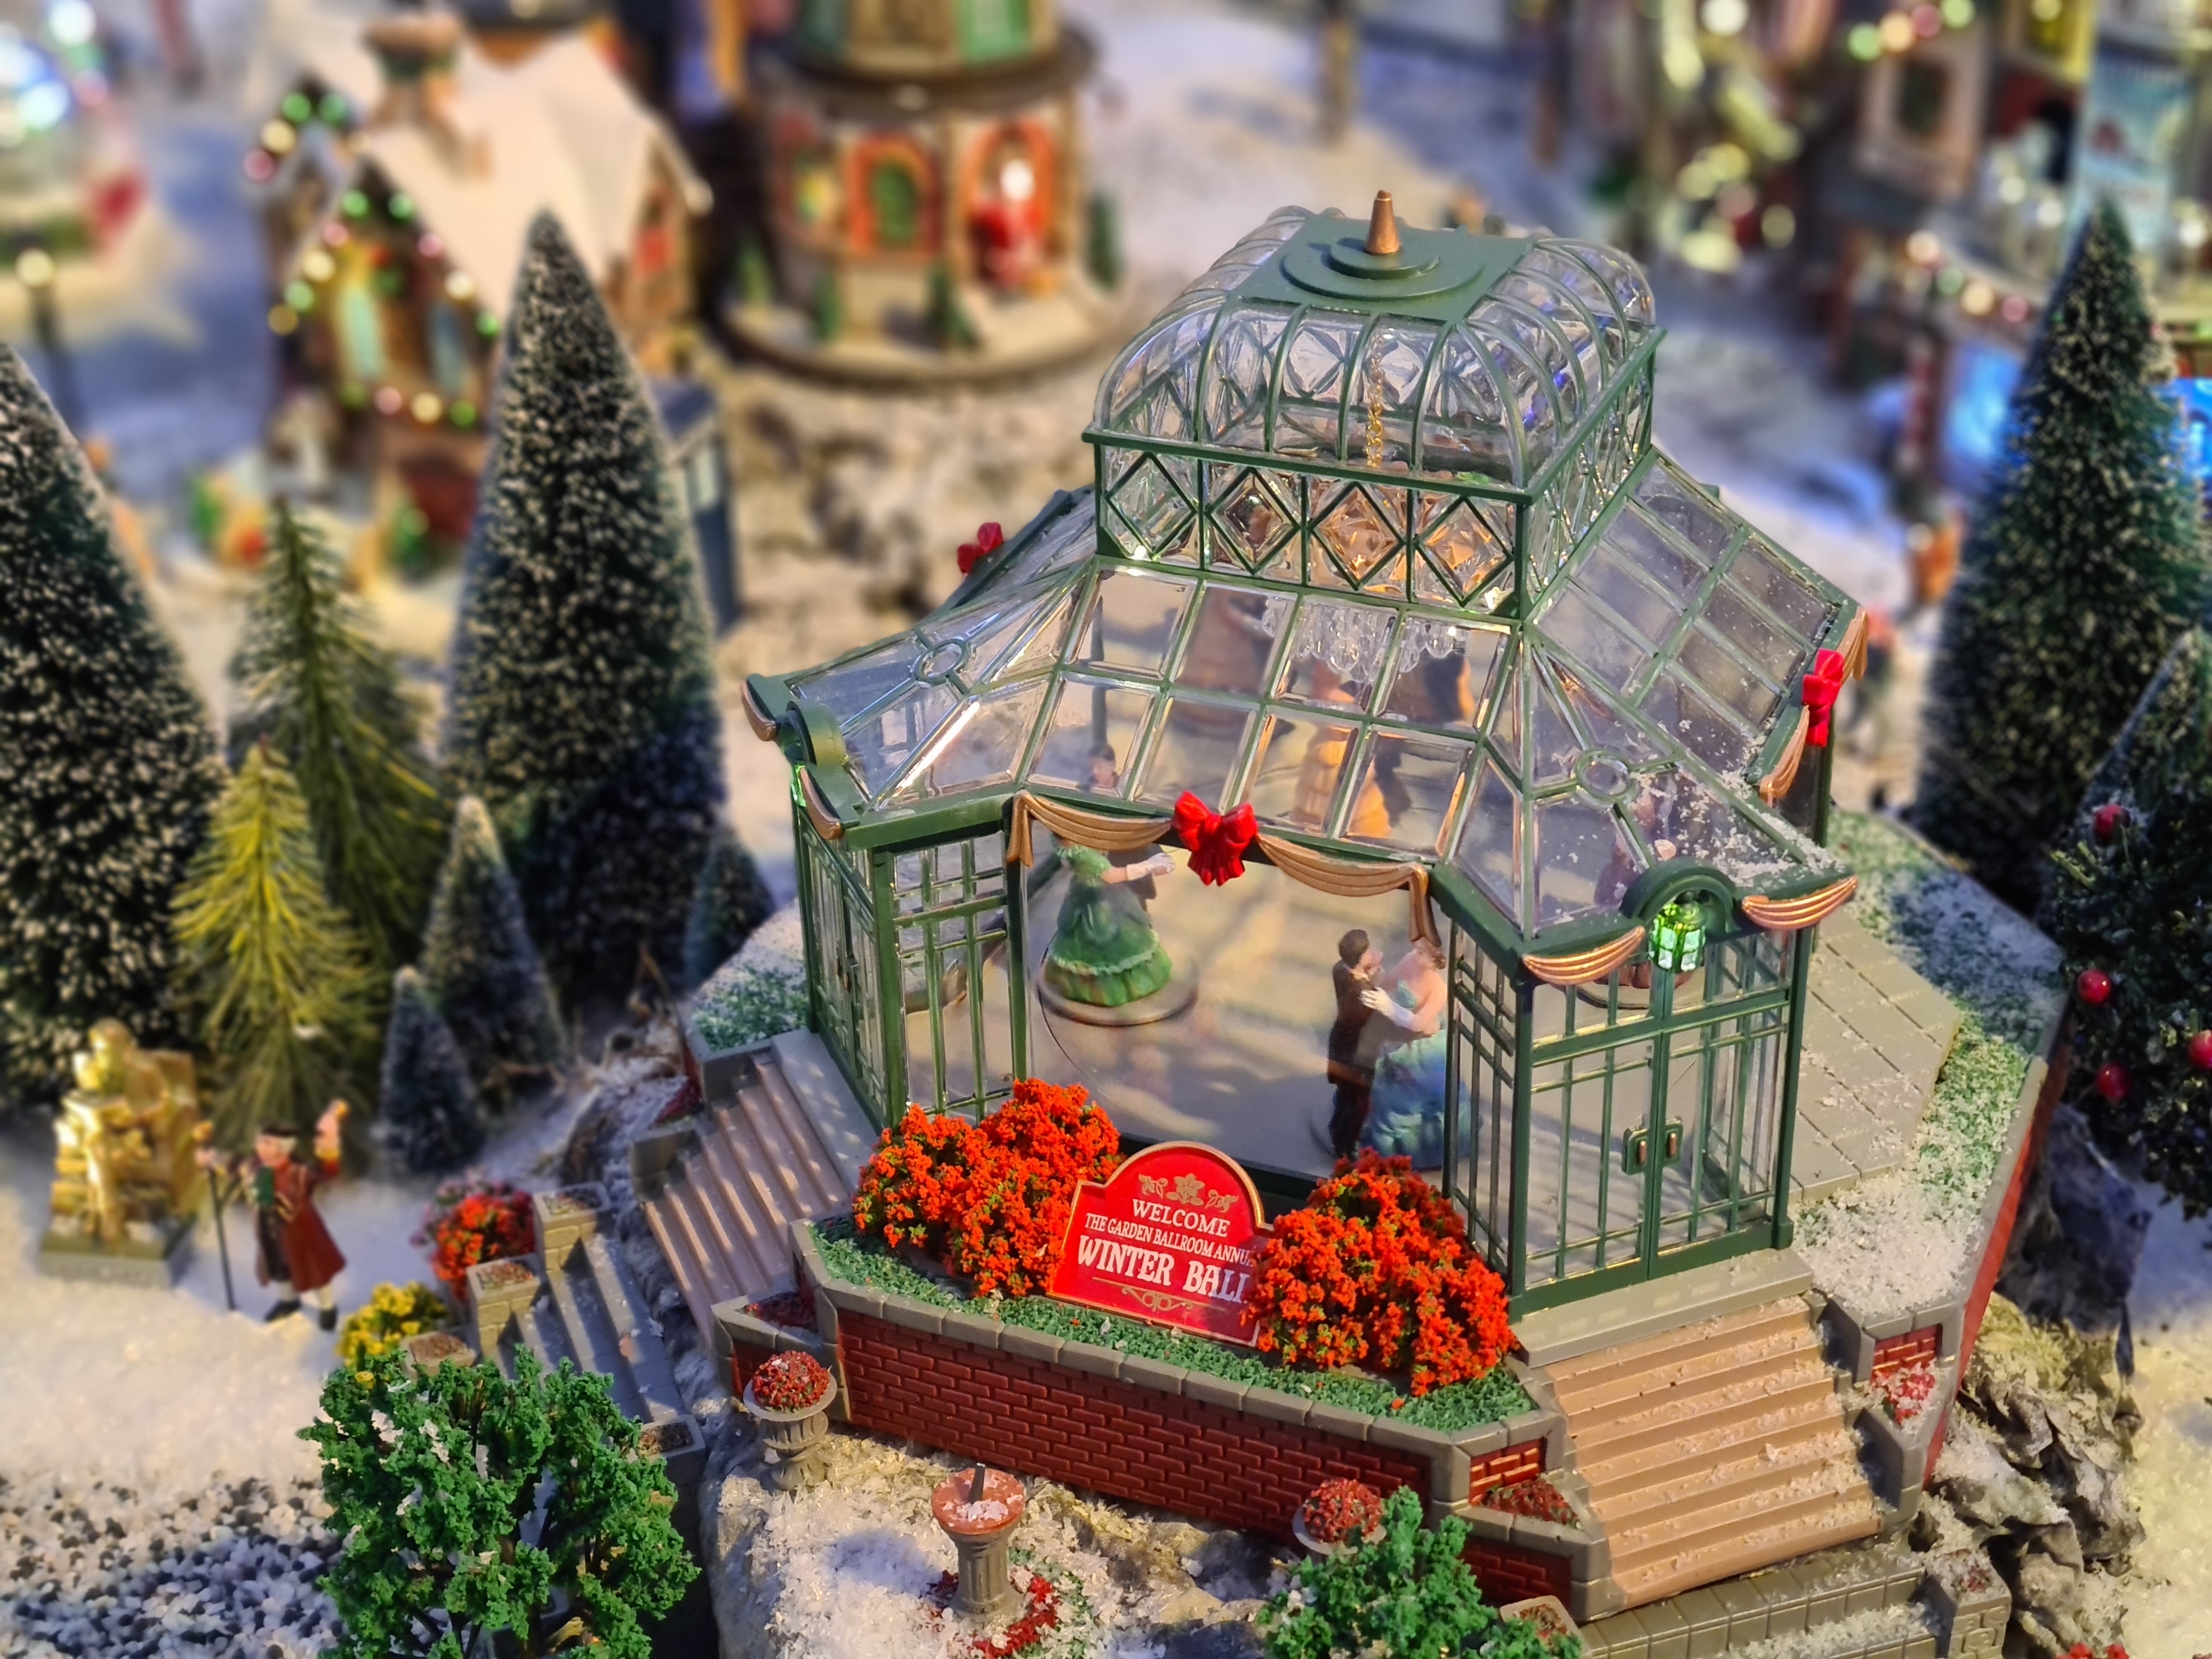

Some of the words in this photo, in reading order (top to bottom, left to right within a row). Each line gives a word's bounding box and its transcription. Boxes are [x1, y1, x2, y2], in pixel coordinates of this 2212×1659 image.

[1085, 1213, 1108, 1232] THE
[1107, 1218, 1154, 1243] GARDEN
[1153, 1228, 1215, 1257] BALLROOM
[1133, 1199, 1230, 1237] WELCOME
[1078, 1234, 1175, 1286] WINTER
